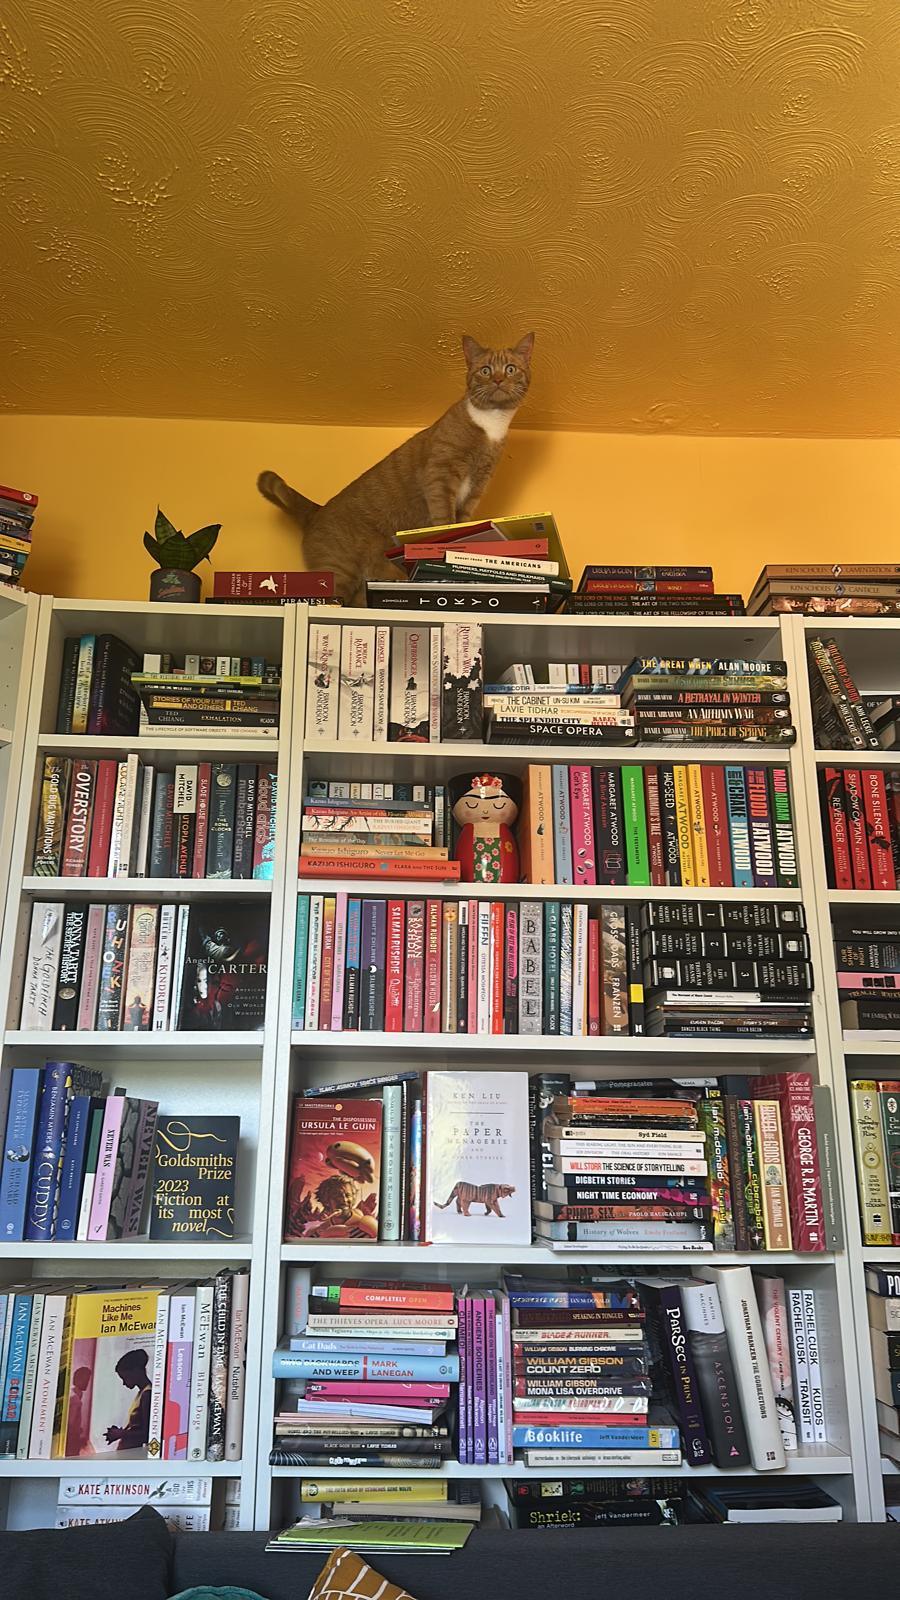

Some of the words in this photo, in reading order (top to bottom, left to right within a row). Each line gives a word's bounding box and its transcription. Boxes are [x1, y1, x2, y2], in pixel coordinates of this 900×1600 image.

[500, 560, 542, 570] AMERICANS
[419, 597, 500, 608] TOKYO
[641, 660, 656, 668] THE
[659, 660, 685, 669] GREAT
[688, 661, 712, 670] WHEN
[718, 662, 740, 671] ALAN
[742, 663, 771, 672] MOORE
[500, 705, 524, 713] LAVIE
[528, 706, 558, 714] TIDHAR
[530, 725, 563, 734] SPACE
[566, 726, 603, 736] OPERA
[691, 726, 704, 736] THE
[706, 726, 728, 737] PRICE
[729, 727, 737, 736] OF
[739, 727, 767, 737] SPRING
[177, 773, 185, 808] MITCHELL
[270, 782, 278, 804] DAVID
[581, 771, 590, 810] MARGARET
[608, 771, 617, 810] MARGARET
[663, 771, 675, 809] HAG-SEED
[773, 769, 790, 821] MADDADDAM
[848, 773, 859, 802] SHADOW
[869, 774, 879, 797] BONE
[69, 772, 91, 853] OVERSTORY
[694, 789, 702, 820] ATWOOD
[711, 792, 719, 822] ATWOOD
[729, 786, 746, 818] CRAKE
[749, 785, 768, 817] FLOOD
[181, 814, 189, 844] UTOPIA
[268, 805, 277, 840] MITCHELL
[584, 811, 592, 846] ATWOOD
[610, 812, 619, 846] ATWOOD
[678, 802, 689, 850] ATWOOD
[832, 796, 844, 844] REVENGER
[851, 802, 862, 845] CAPTAIN
[872, 797, 884, 837] SILENCE
[179, 845, 188, 875] AVENUE
[667, 831, 676, 864] ATWOOD
[731, 828, 751, 870] ATWOOD
[753, 828, 774, 876] ATWOOD
[776, 829, 797, 875] ATWOOD
[73, 911, 84, 945] DONNA
[391, 906, 401, 939] SALMAN
[480, 913, 490, 946] EILEEN
[549, 915, 557, 947] GLASS
[407, 917, 415, 959] RUSHDIE
[414, 917, 423, 959] SALMAN
[609, 911, 619, 969] CROSSROADS
[71, 949, 81, 984] TARTT
[185, 956, 215, 964] Angela
[208, 964, 268, 974] CARTER
[390, 940, 400, 975] RUSHDIE
[526, 919, 538, 1015] BABEL
[548, 948, 557, 972] HOTEL
[156, 964, 168, 1013] KINDRED
[611, 977, 621, 1018] FRANZEN
[48, 1086, 58, 1121] BENJAMIN
[319, 1084, 337, 1093] ISAAC
[45, 1122, 53, 1144] MYERS
[339, 1122, 350, 1130] LE
[453, 1128, 502, 1137] PAPER
[638, 1131, 648, 1139] Syd
[650, 1131, 668, 1139] Field
[158, 1153, 233, 1167] Goldsmiths
[569, 1161, 584, 1171] WILL
[583, 1161, 602, 1171] STORR
[602, 1162, 612, 1171] THE
[612, 1162, 636, 1172] SCIENCE
[636, 1163, 645, 1171] OF
[644, 1163, 685, 1173] STORYTELLING
[763, 1140, 781, 1164] GODS
[156, 1179, 189, 1192] 2023
[199, 1167, 232, 1180] Prize
[575, 1175, 605, 1185] DIGBETH
[606, 1176, 636, 1186] STORIES
[31, 1162, 54, 1231] CUDDY
[155, 1193, 202, 1206] Fiction
[217, 1195, 229, 1206] at
[576, 1191, 599, 1200] NIGHT
[600, 1191, 620, 1200] TIME
[622, 1191, 658, 1201] ECONOMY
[158, 1206, 174, 1219] its
[189, 1207, 222, 1219] most
[171, 1218, 208, 1232] novel
[18, 1301, 29, 1322] IAN
[102, 1304, 142, 1314] Machines
[102, 1313, 119, 1323] Like
[120, 1312, 133, 1321] Me
[234, 1310, 243, 1324] Ian
[364, 1318, 388, 1326] OPERA
[791, 1292, 804, 1333] RACHEL
[804, 1293, 817, 1334] RACHEL
[12, 1325, 27, 1373] McEWAN
[233, 1326, 243, 1359] McEwan
[302, 1341, 316, 1350] Cat
[317, 1342, 337, 1350] Dads
[795, 1335, 807, 1364] CUSK
[808, 1335, 818, 1366] CUSK
[312, 1368, 332, 1376] AND
[333, 1369, 360, 1377] WEEP
[371, 1369, 414, 1378] LANEGAN
[526, 1357, 577, 1365] WILLIAM
[578, 1357, 624, 1365] GIBSON
[526, 1365, 570, 1374] COUNT
[569, 1365, 601, 1374] ZERO
[231, 1366, 241, 1401] Nutshell
[527, 1379, 564, 1387] WILLIAM
[565, 1380, 598, 1388] GIBSON
[527, 1386, 555, 1395] MONA
[555, 1386, 575, 1395] LISA
[576, 1386, 623, 1396] OVERDRIVE
[800, 1379, 813, 1426] TRANSIT
[812, 1387, 824, 1426] KUDOS
[527, 1431, 583, 1443] Booklife
[78, 1484, 100, 1496] KATE
[103, 1484, 150, 1496] ATKINSON
[529, 1510, 581, 1524] Shriek:
